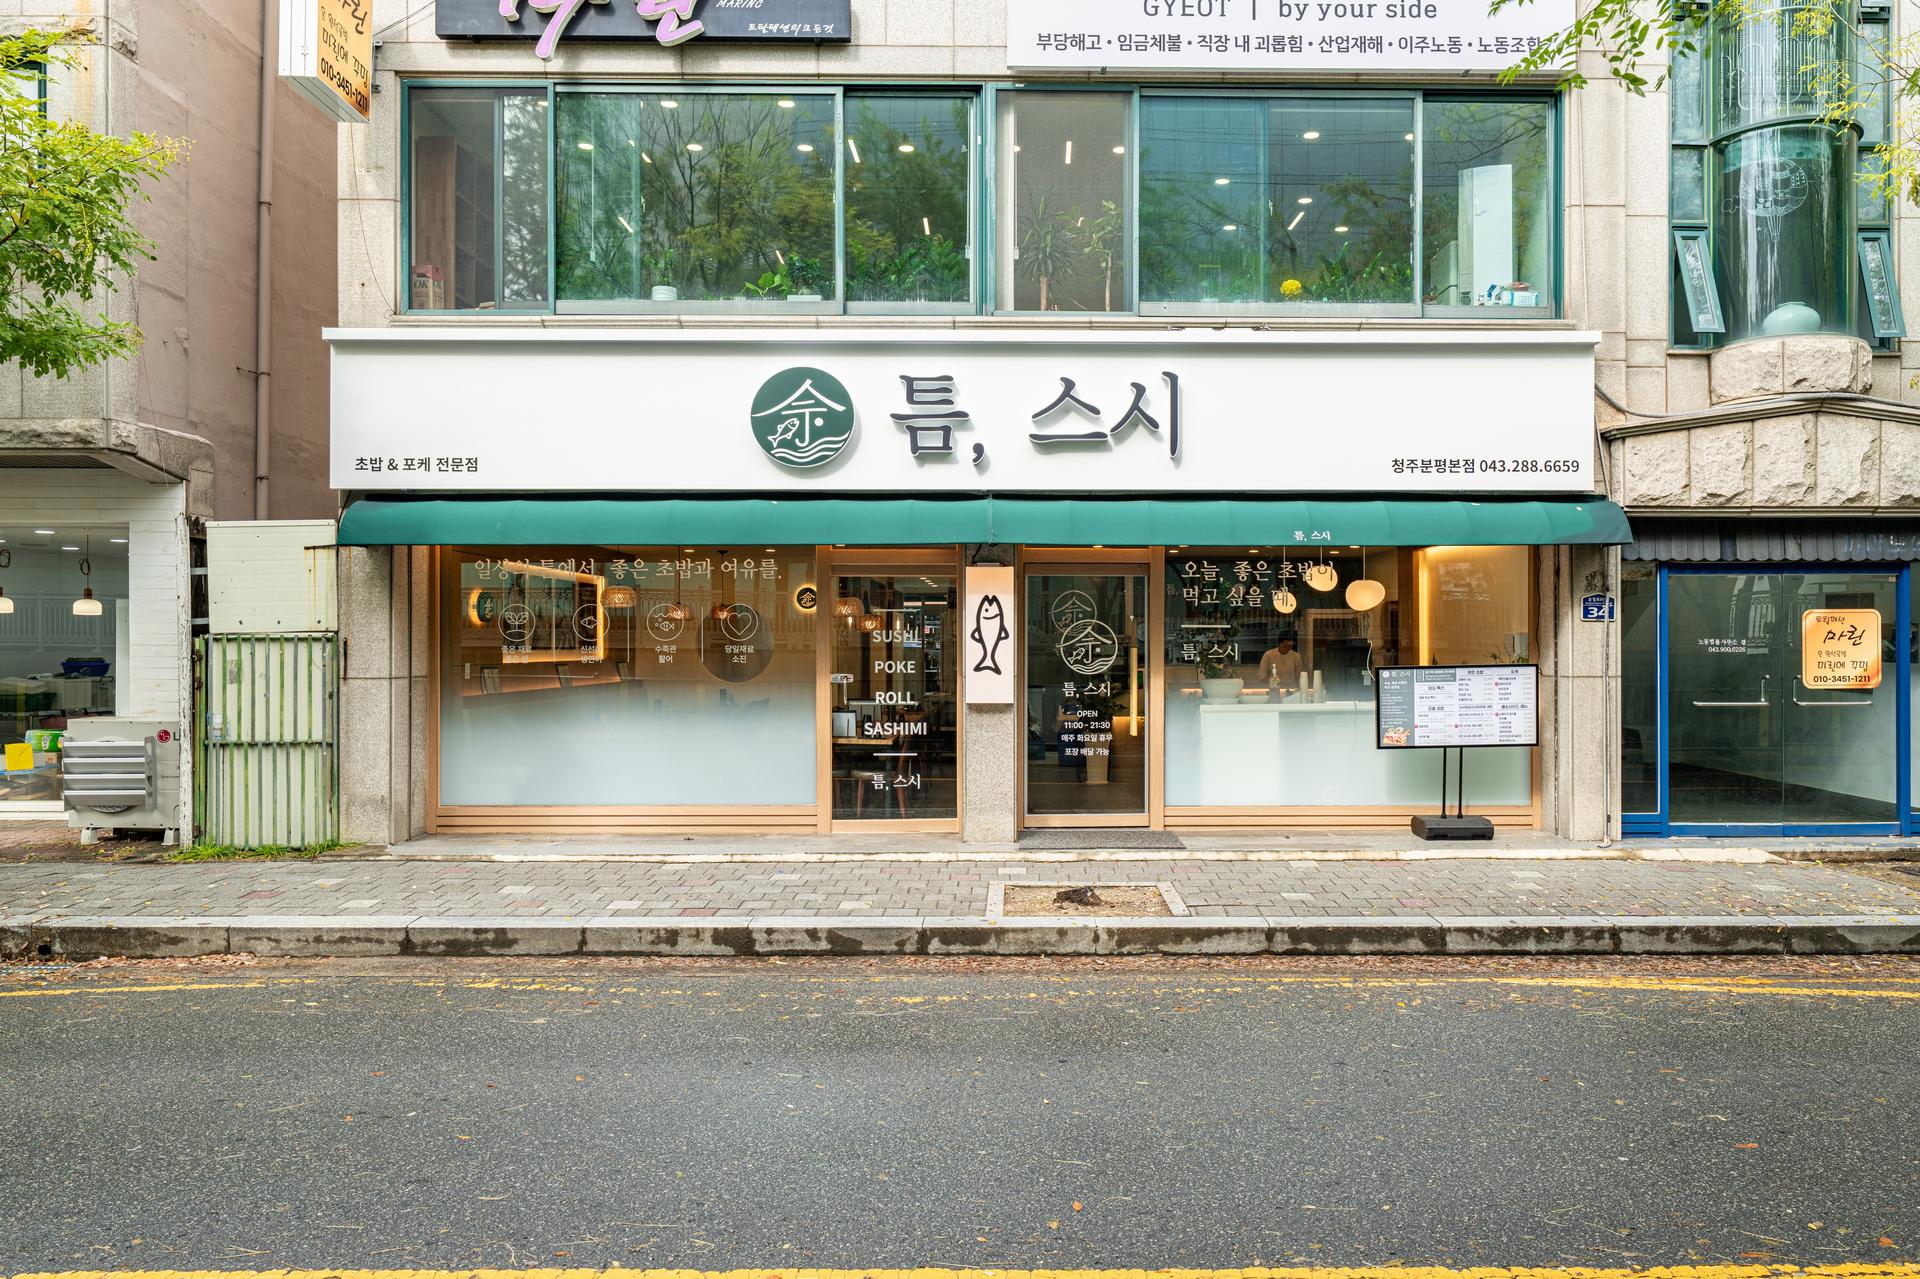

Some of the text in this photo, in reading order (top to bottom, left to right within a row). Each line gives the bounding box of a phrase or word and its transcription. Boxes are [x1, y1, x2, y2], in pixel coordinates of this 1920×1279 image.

[1143, 0, 1437, 21] GYEOT by your side
[1036, 33, 1102, 51] 부당해고
[1117, 33, 1183, 52] 임금체불
[1197, 34, 1230, 52] 직장
[1234, 34, 1250, 52] 내
[1254, 35, 1303, 53] 괴롭힘
[1318, 35, 1383, 53] 산업재해
[1398, 36, 1463, 54] 이주노동
[320, 57, 369, 112] 010-3451-1211
[889, 370, 1180, 466] 틈, 스시
[354, 456, 478, 472] 초밥 & 포케 전문점
[1391, 458, 1580, 474] 청주분평본점 043.288.6659
[1311, 530, 1331, 541] 스시
[610, 558, 649, 579] 좋은
[655, 558, 714, 579] 초밥과
[720, 558, 782, 579] 여유를.
[1181, 560, 1333, 583] 오늘, 좋은 초밥이
[1182, 586, 1220, 607] 먹고
[1226, 586, 1265, 607] 싶을
[872, 630, 920, 643] SUSHI
[1823, 625, 1866, 646] 마린
[1208, 643, 1238, 661] 스시
[874, 660, 916, 674] POKE
[1813, 675, 1871, 683] 010-3451-1211
[1083, 681, 1111, 697] 스시
[1076, 710, 1098, 718] OPEN
[864, 722, 928, 735] SASHIMI
[1063, 721, 1084, 729] 11:00
[1090, 721, 1111, 729] 21:30
[173, 731, 180, 741] L
[893, 773, 921, 790] 스시
